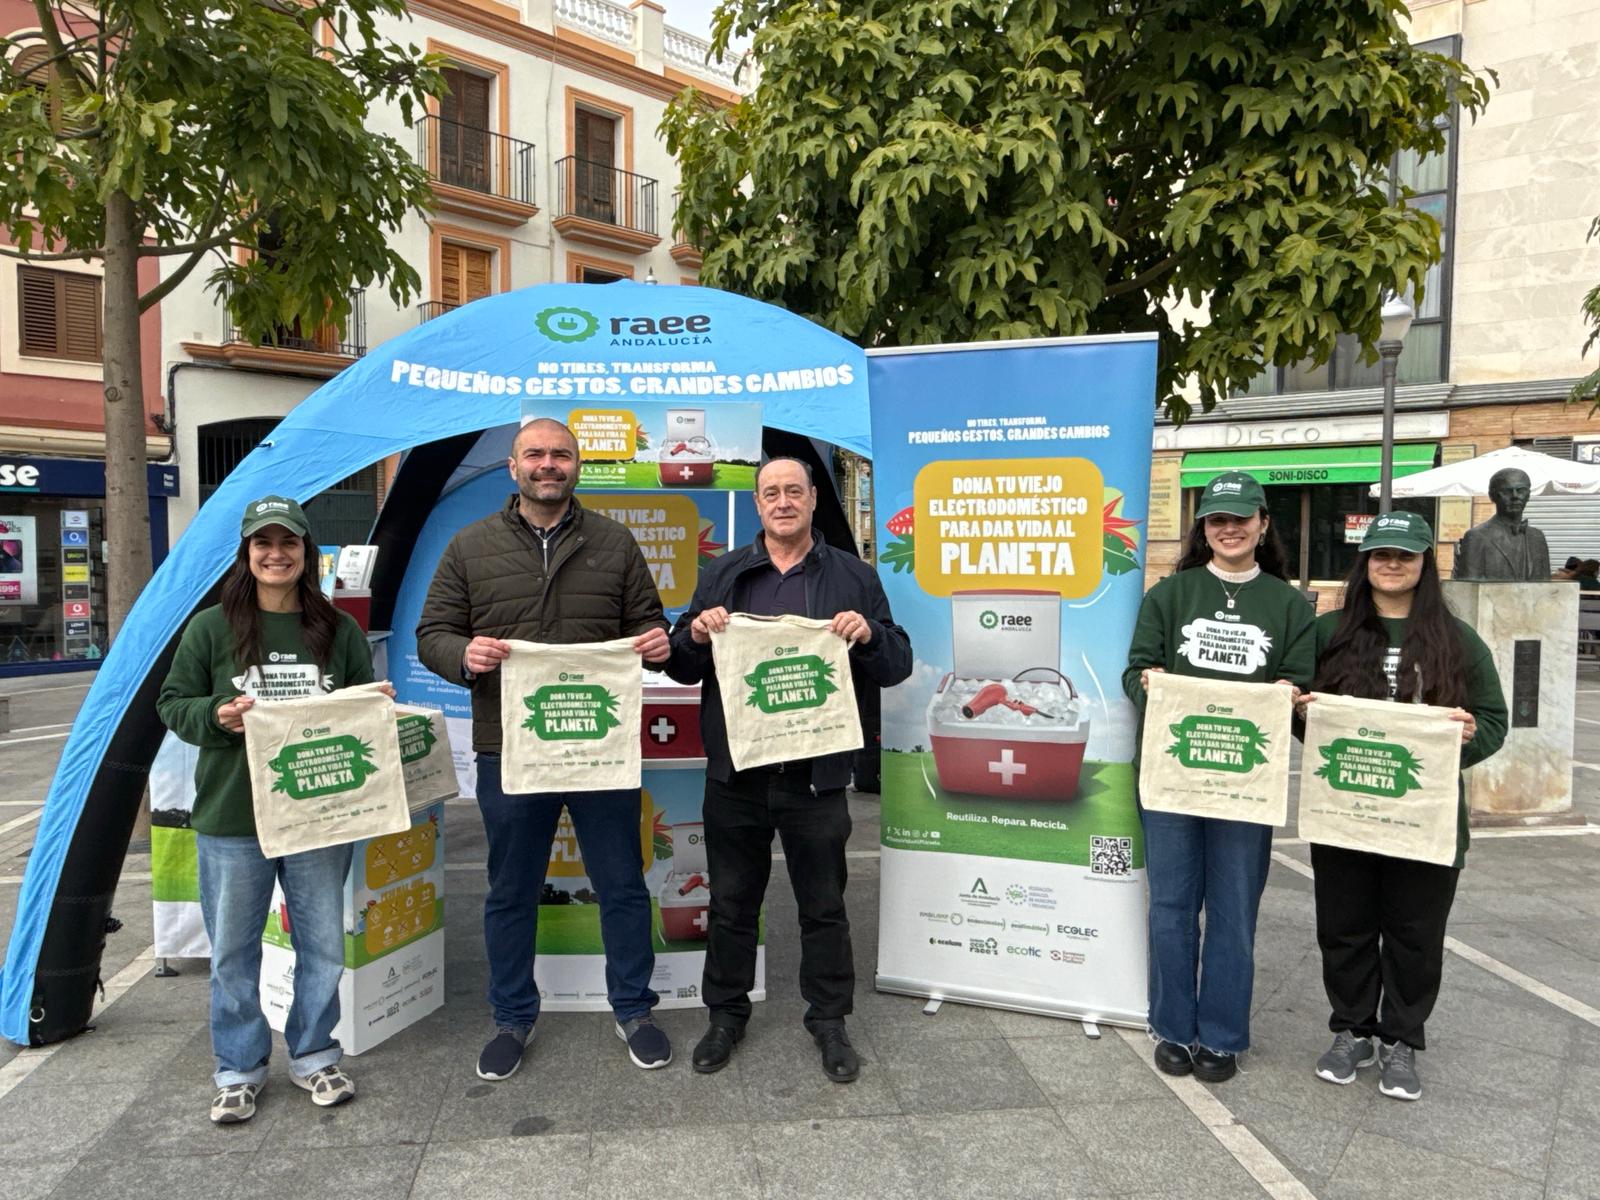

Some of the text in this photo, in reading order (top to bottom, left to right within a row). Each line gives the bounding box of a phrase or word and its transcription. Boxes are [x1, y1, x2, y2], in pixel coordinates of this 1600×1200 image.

[610, 315, 711, 335] raee
[610, 335, 712, 346] ANDALUCÍA
[538, 361, 717, 375] NO TIRES, TRANSFORMA
[391, 360, 854, 396] PEQUEÑOS GESTOS, GRANDES CAMBIOS
[967, 419, 977, 427] NO
[999, 416, 1046, 426] TRANSFORMA
[908, 425, 1110, 444] PEQUEÑOS GESTOS, GRANDES CAMBIOS
[577, 438, 627, 451] PLANETA
[953, 475, 1063, 494] DONA TU VIEJO
[1269, 470, 1328, 481] SONI-DISCO
[929, 494, 1087, 516] ELECTRODOMÉSTICO
[628, 509, 666, 524] VIEJO
[940, 520, 1075, 537] PARA DAR VIDA AL
[659, 545, 676, 559] AL
[941, 542, 1075, 575] PLANETA
[1001, 615, 1032, 626] raee
[1198, 647, 1247, 666] PLANETA
[767, 687, 817, 707] PLANETA
[545, 718, 598, 733] PLANETA
[1189, 747, 1243, 765] PLANETA
[296, 769, 355, 792] PLANETA
[1339, 770, 1396, 790] PLANETA
[946, 812, 1069, 831] Reutiliza. Repara. Recicla.
[1006, 946, 1042, 958] ecotic
